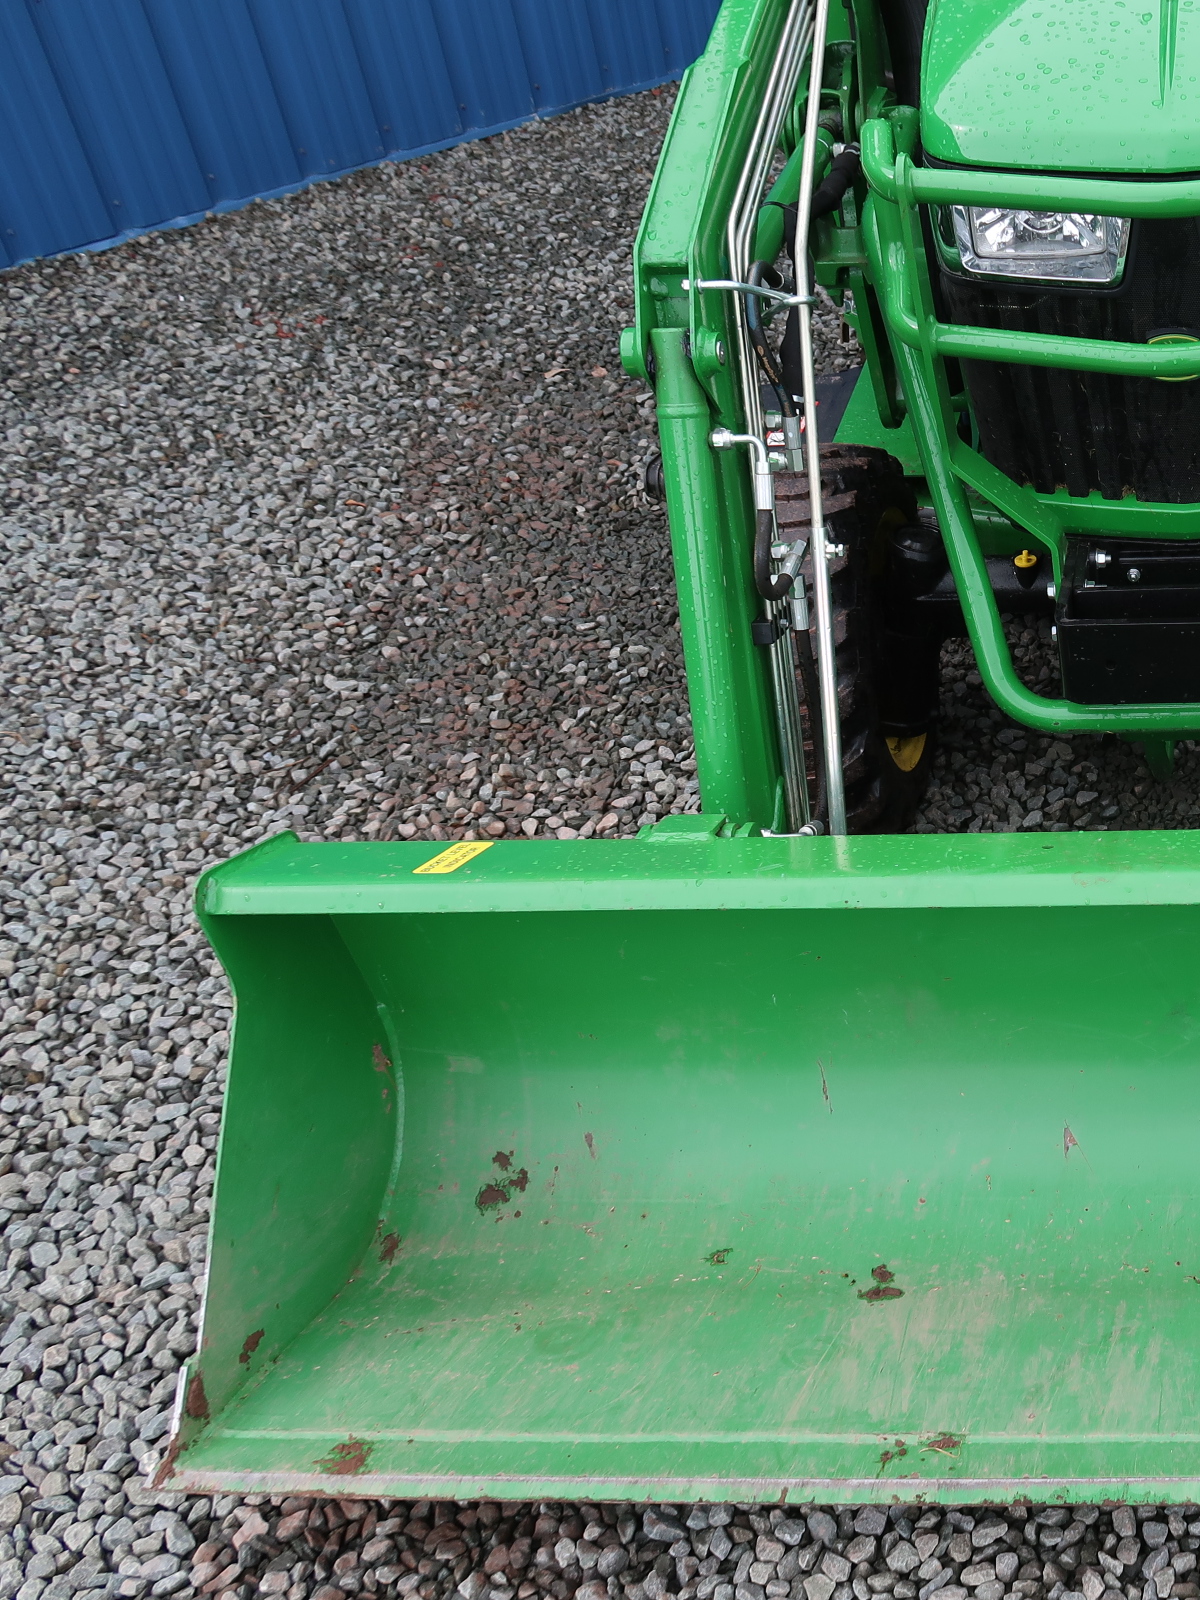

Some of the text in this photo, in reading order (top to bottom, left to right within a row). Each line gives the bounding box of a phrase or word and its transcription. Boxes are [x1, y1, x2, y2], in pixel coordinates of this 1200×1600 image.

[420, 843, 472, 872] BUCKET LEVEL
[443, 846, 481, 868] INDICATOR
